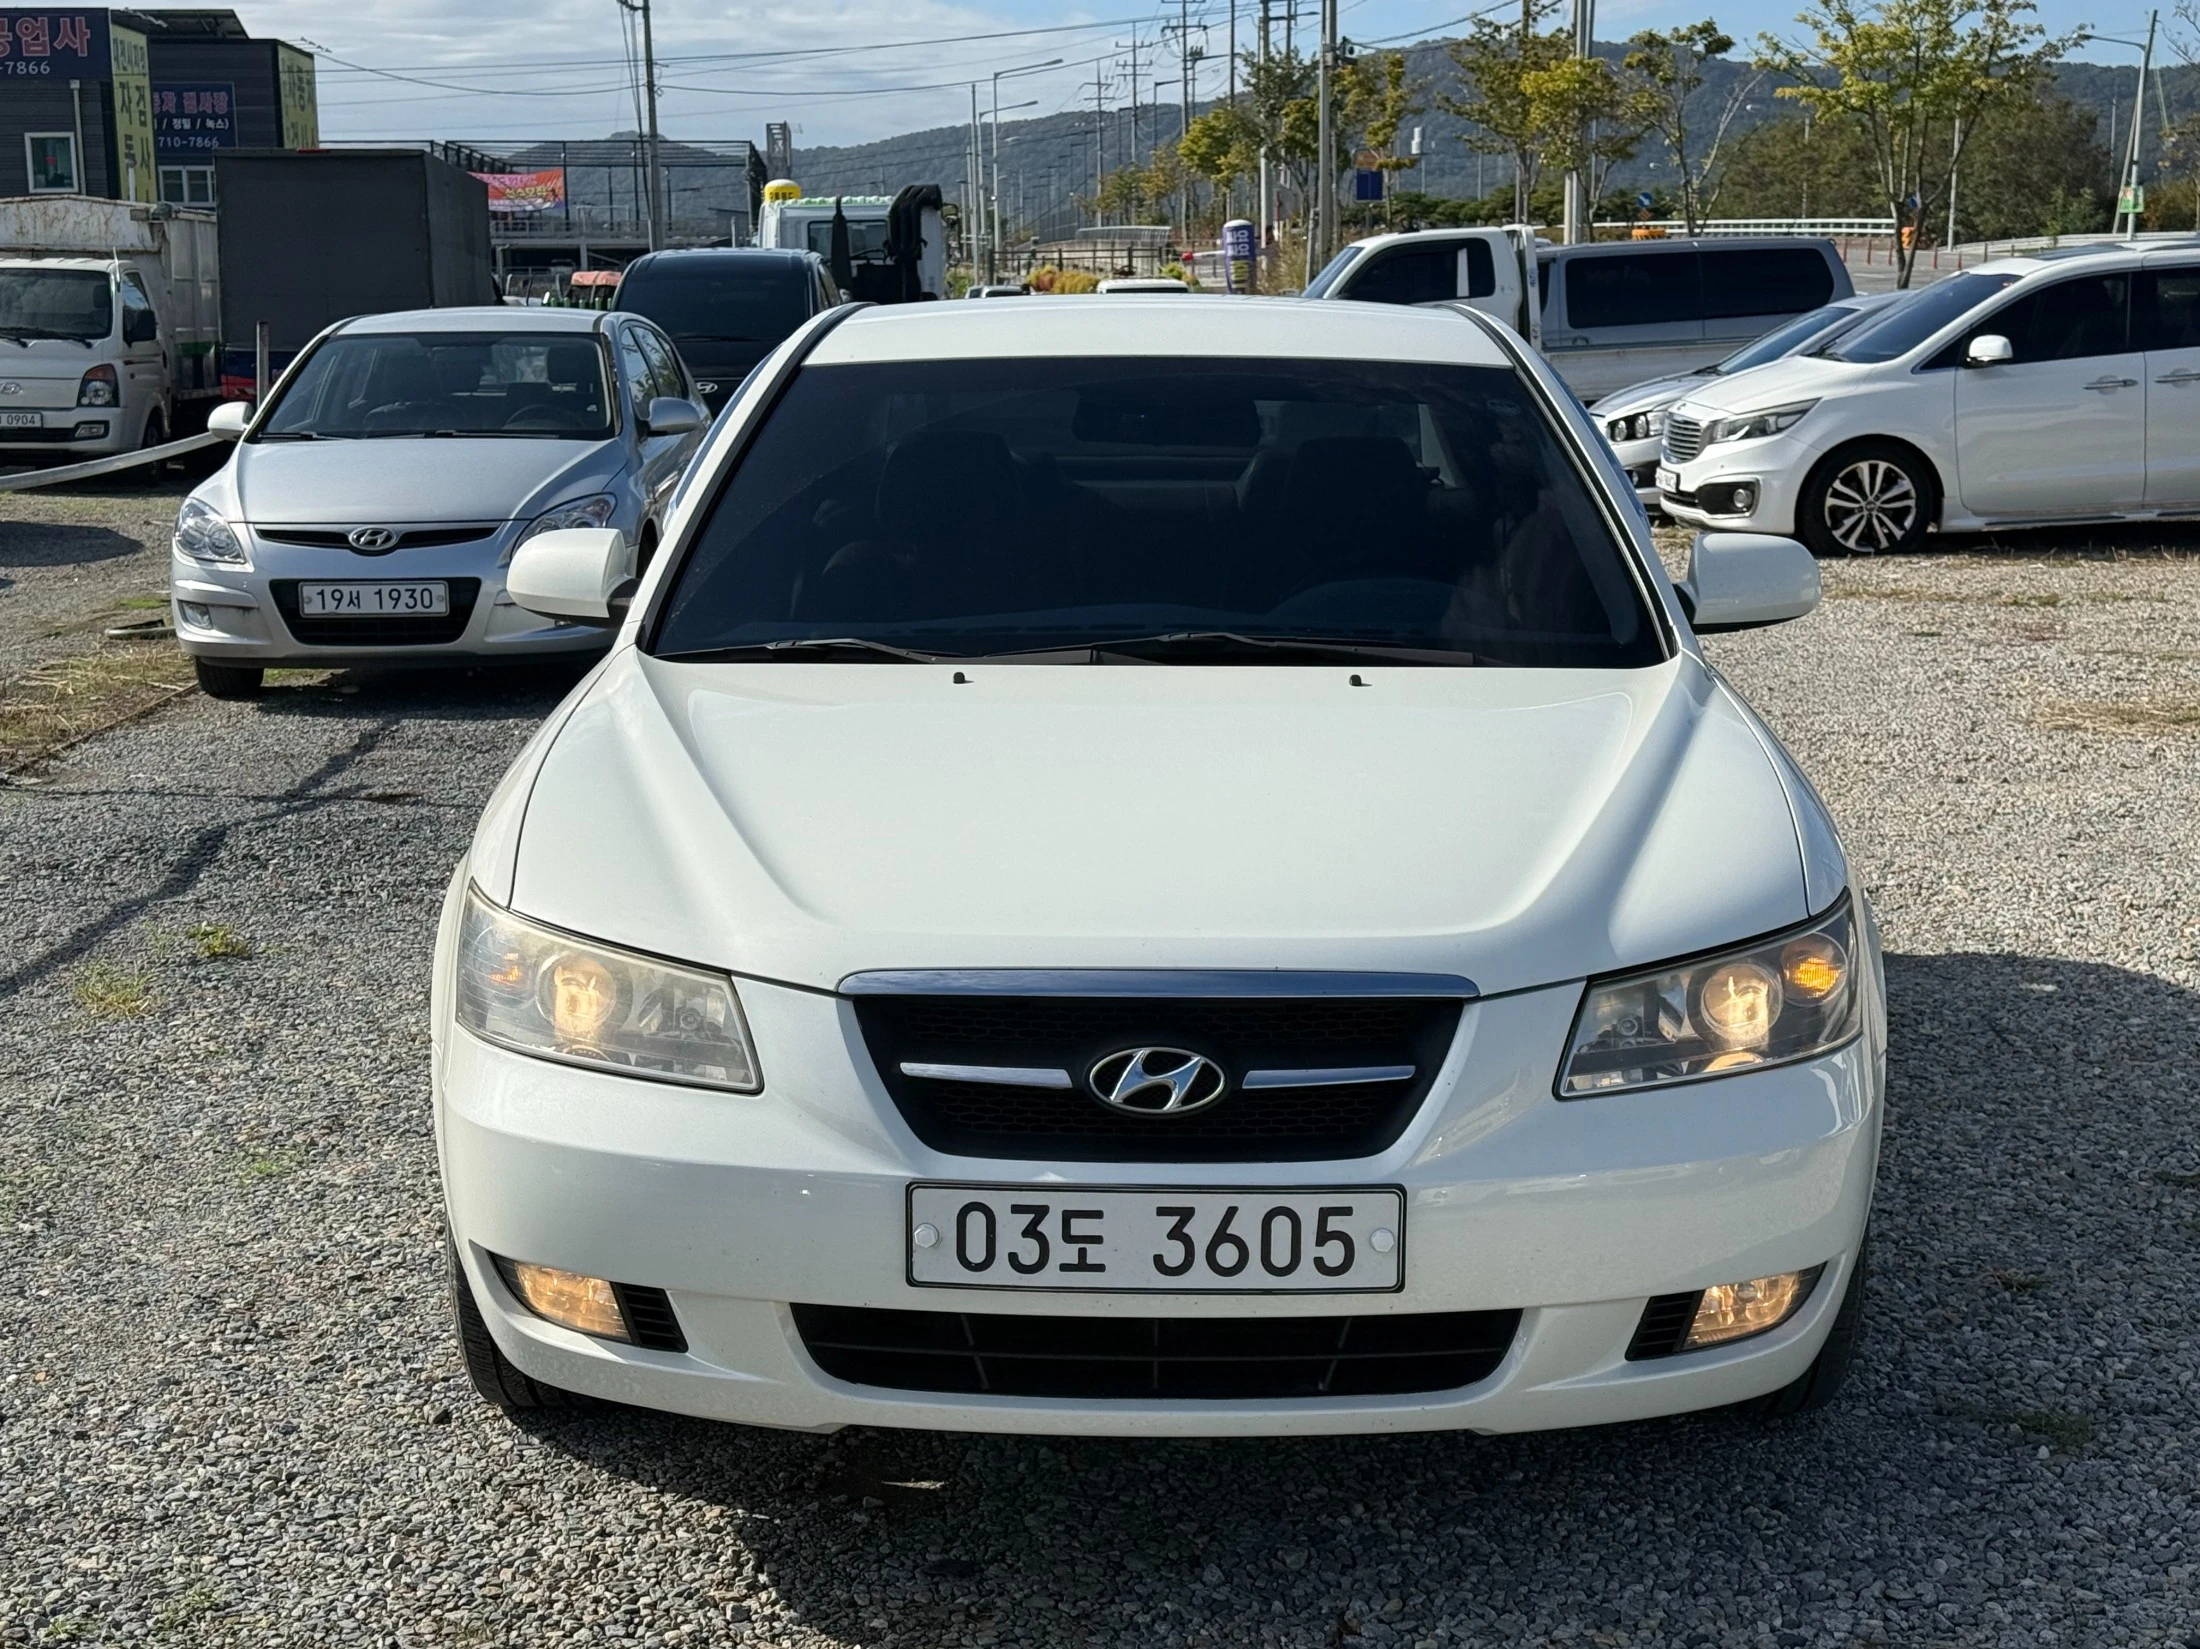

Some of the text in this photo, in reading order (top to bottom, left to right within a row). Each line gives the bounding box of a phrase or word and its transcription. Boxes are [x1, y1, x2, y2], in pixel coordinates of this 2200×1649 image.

[158, 136, 220, 148] 710-7866
[6, 414, 36, 426] 0904
[316, 587, 434, 611] 19서 1930
[955, 1200, 1356, 1278] 03도 3605
